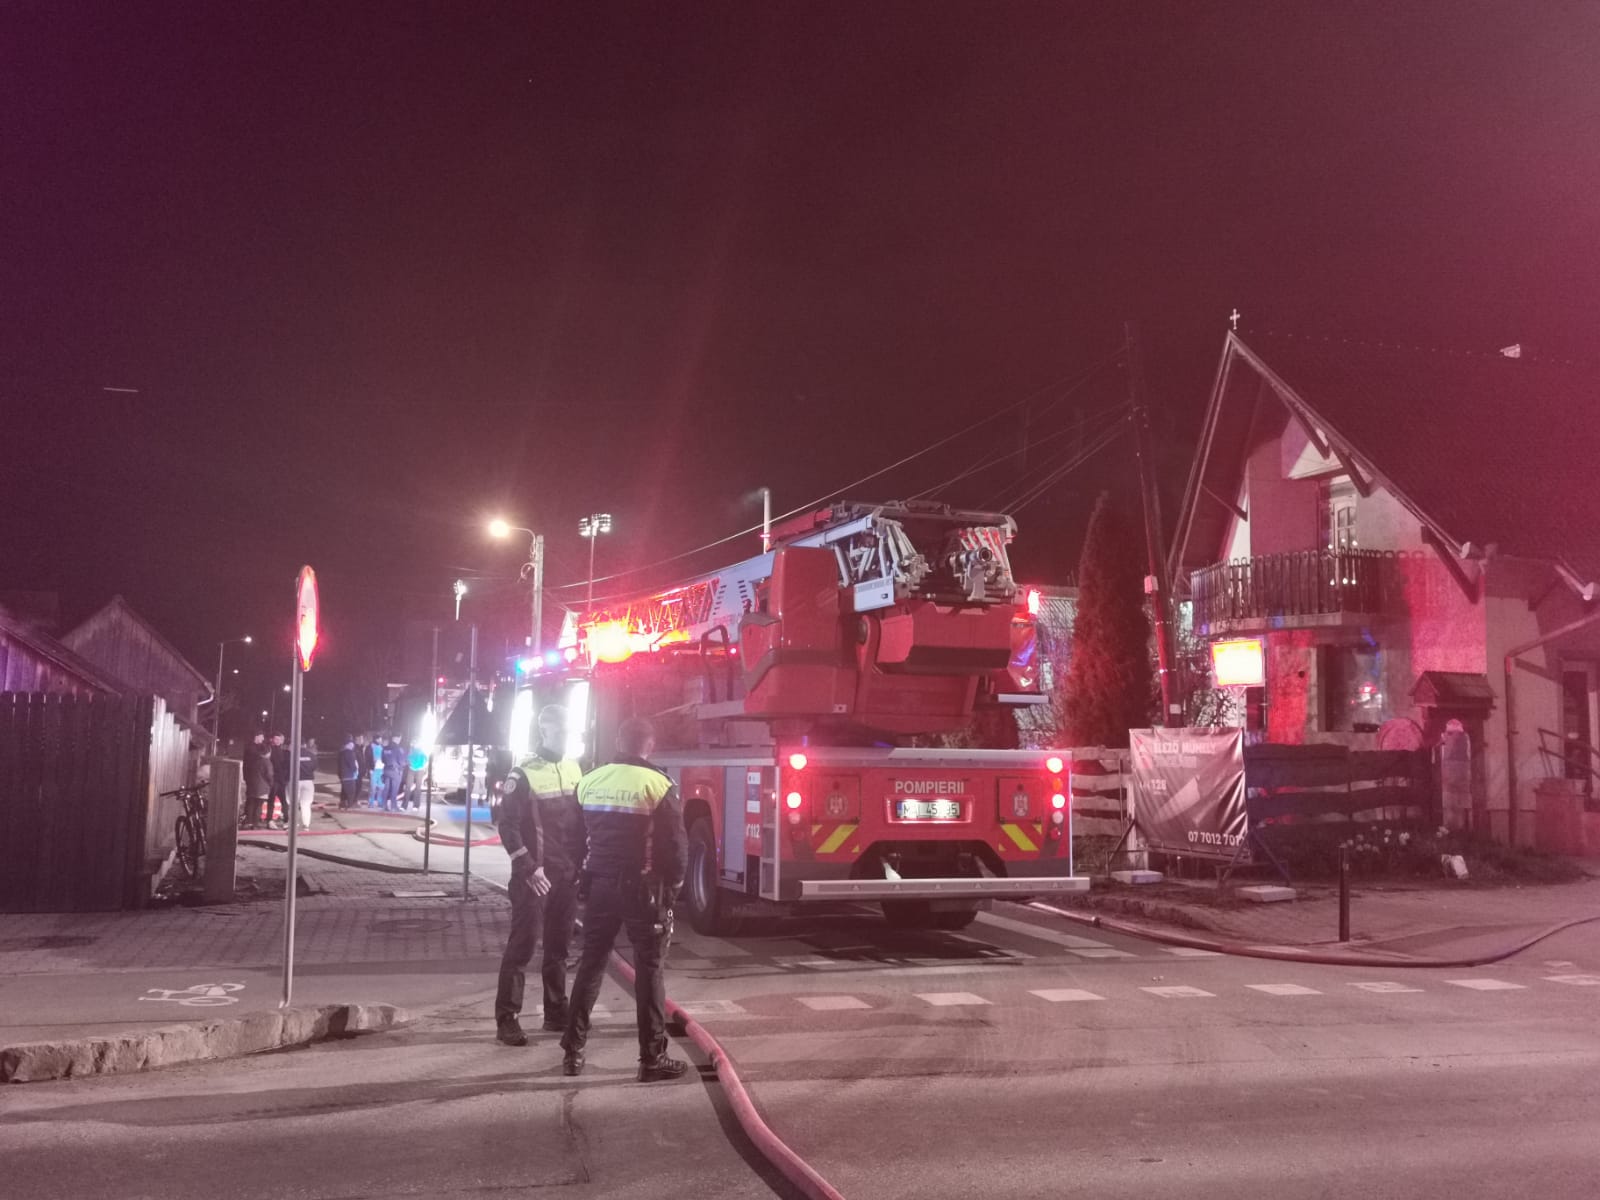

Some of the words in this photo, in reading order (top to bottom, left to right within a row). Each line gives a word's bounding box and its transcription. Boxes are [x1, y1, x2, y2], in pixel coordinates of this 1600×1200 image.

[895, 781, 965, 794] POMPIERII
[1188, 831, 1199, 843] 07
[1201, 831, 1222, 845] 7012
